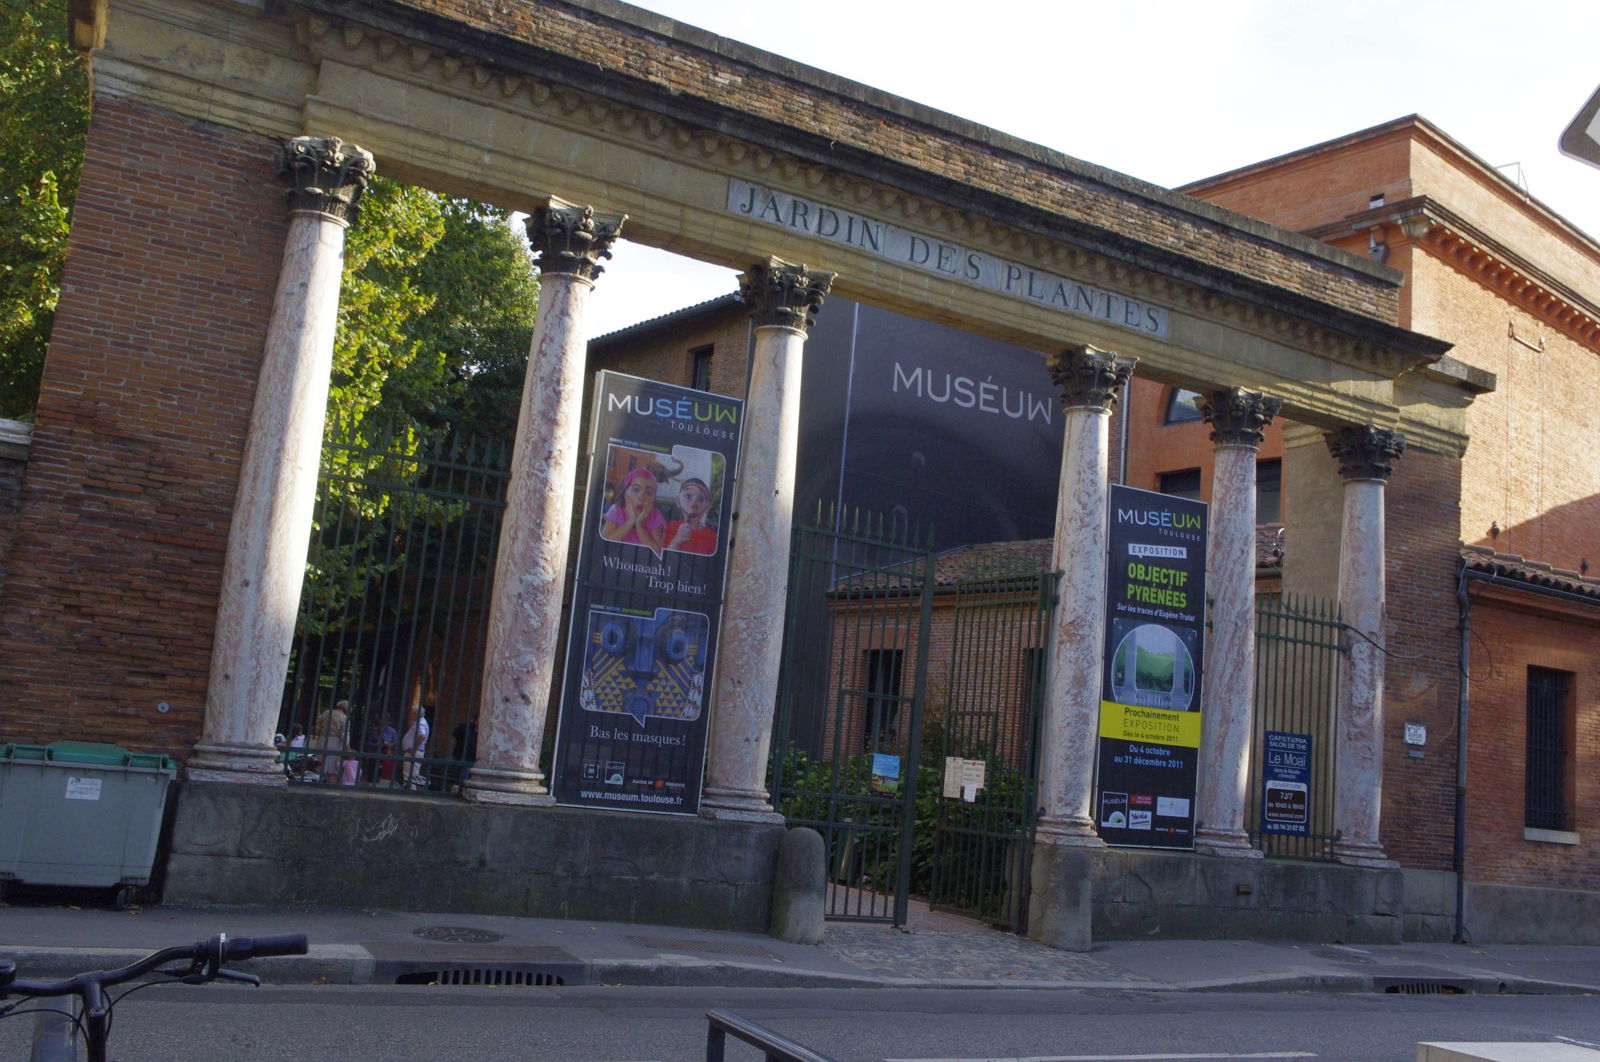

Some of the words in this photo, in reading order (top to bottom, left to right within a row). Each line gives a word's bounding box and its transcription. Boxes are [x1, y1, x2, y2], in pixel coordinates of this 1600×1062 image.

[740, 188, 881, 252] JARDIN
[910, 236, 981, 281] DES
[1006, 264, 1160, 332] PLANTES
[670, 420, 735, 440] TOULOUSE
[1158, 528, 1201, 542] TOULOUSE
[1132, 545, 1184, 556] EXPOSITION
[1128, 562, 1188, 587] OBJECTIF
[646, 576, 674, 594] Trop
[1127, 582, 1188, 608] PYRÉNÉES
[1116, 602, 1127, 610] Sur
[1137, 606, 1153, 616] traces
[1124, 707, 1180, 721] Prochainement
[590, 725, 611, 739] Bas
[614, 728, 629, 740] les
[1124, 718, 1180, 733] EXPOSITION
[1129, 744, 1138, 752] Du
[1146, 747, 1171, 756] octobre
[1134, 756, 1167, 767] décembre
[1168, 760, 1183, 768] 2011
[1268, 752, 1281, 765] Le
[580, 790, 683, 805] www.museum.toulouse.fr
